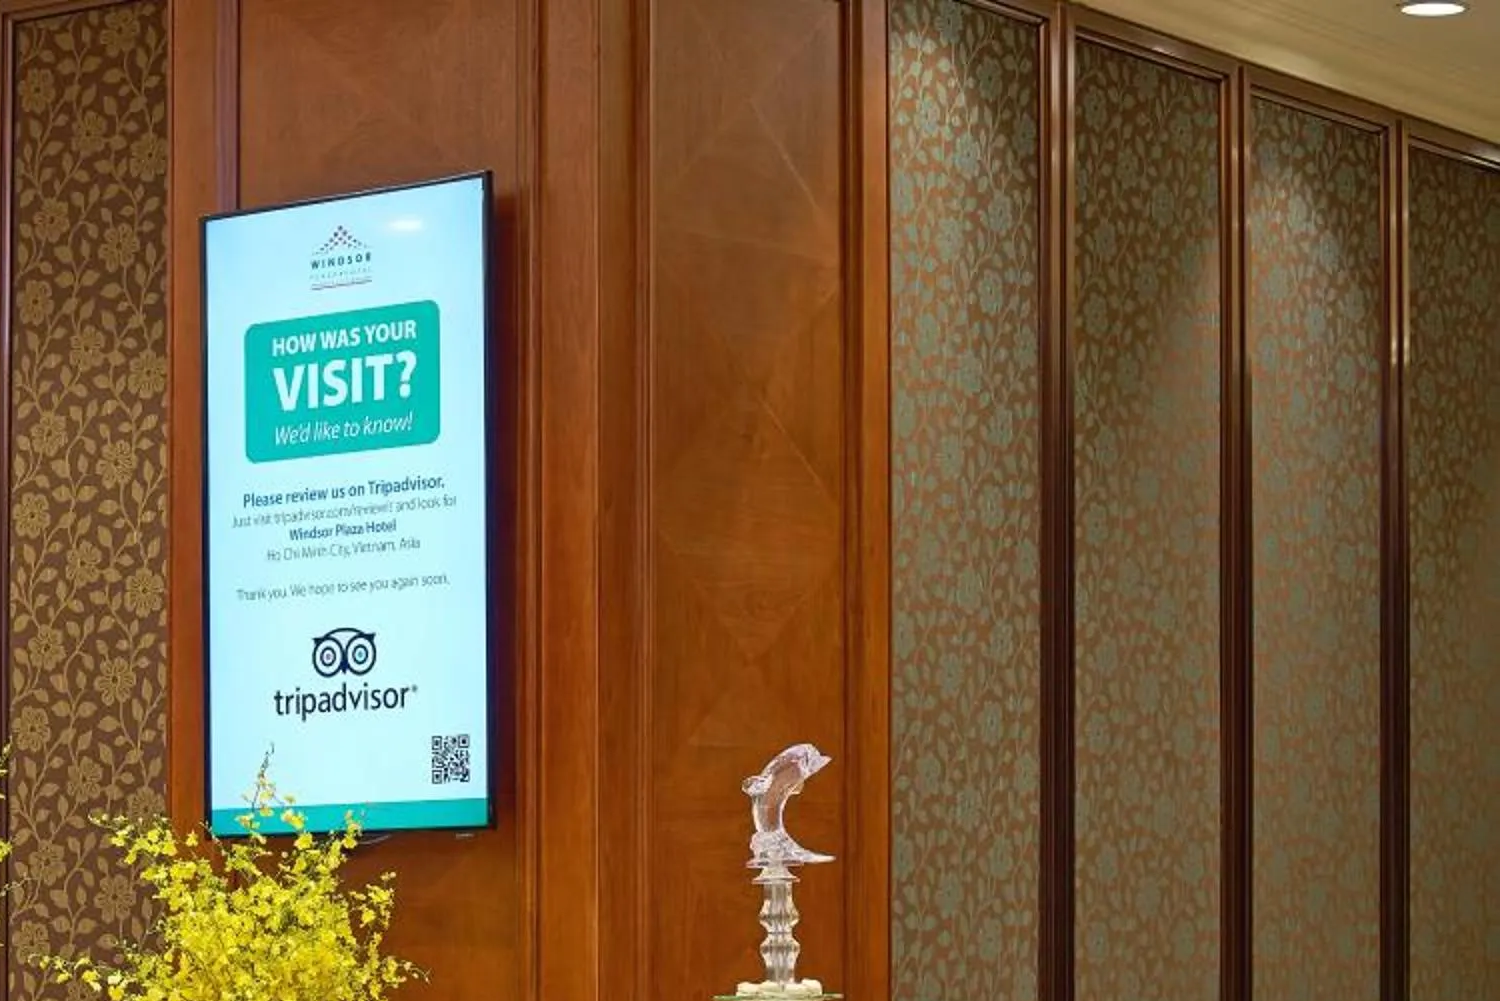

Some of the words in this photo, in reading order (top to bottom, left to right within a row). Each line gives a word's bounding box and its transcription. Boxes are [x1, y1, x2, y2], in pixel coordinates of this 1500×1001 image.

[272, 333, 316, 357] HOW
[320, 327, 360, 349] WAS
[364, 319, 416, 344] YOUR
[273, 350, 417, 412] VISIT?
[275, 421, 311, 446] We'd
[313, 421, 341, 441] like
[343, 421, 360, 437] to
[363, 410, 413, 436] know!
[243, 491, 283, 508] Please
[285, 487, 328, 504] review
[331, 486, 345, 499] us
[348, 484, 365, 497] on
[368, 475, 445, 497] Tripadvisor.
[396, 497, 416, 512] and
[417, 495, 441, 510] look
[443, 493, 456, 507] for
[289, 525, 333, 541] Windsor
[335, 522, 364, 537] Plaza
[365, 517, 396, 533] Hotel
[289, 582, 307, 597] We
[336, 582, 348, 593] to
[350, 579, 367, 593] see
[369, 578, 389, 594] you
[390, 575, 418, 592] again
[274, 682, 410, 721] tripadvisor
